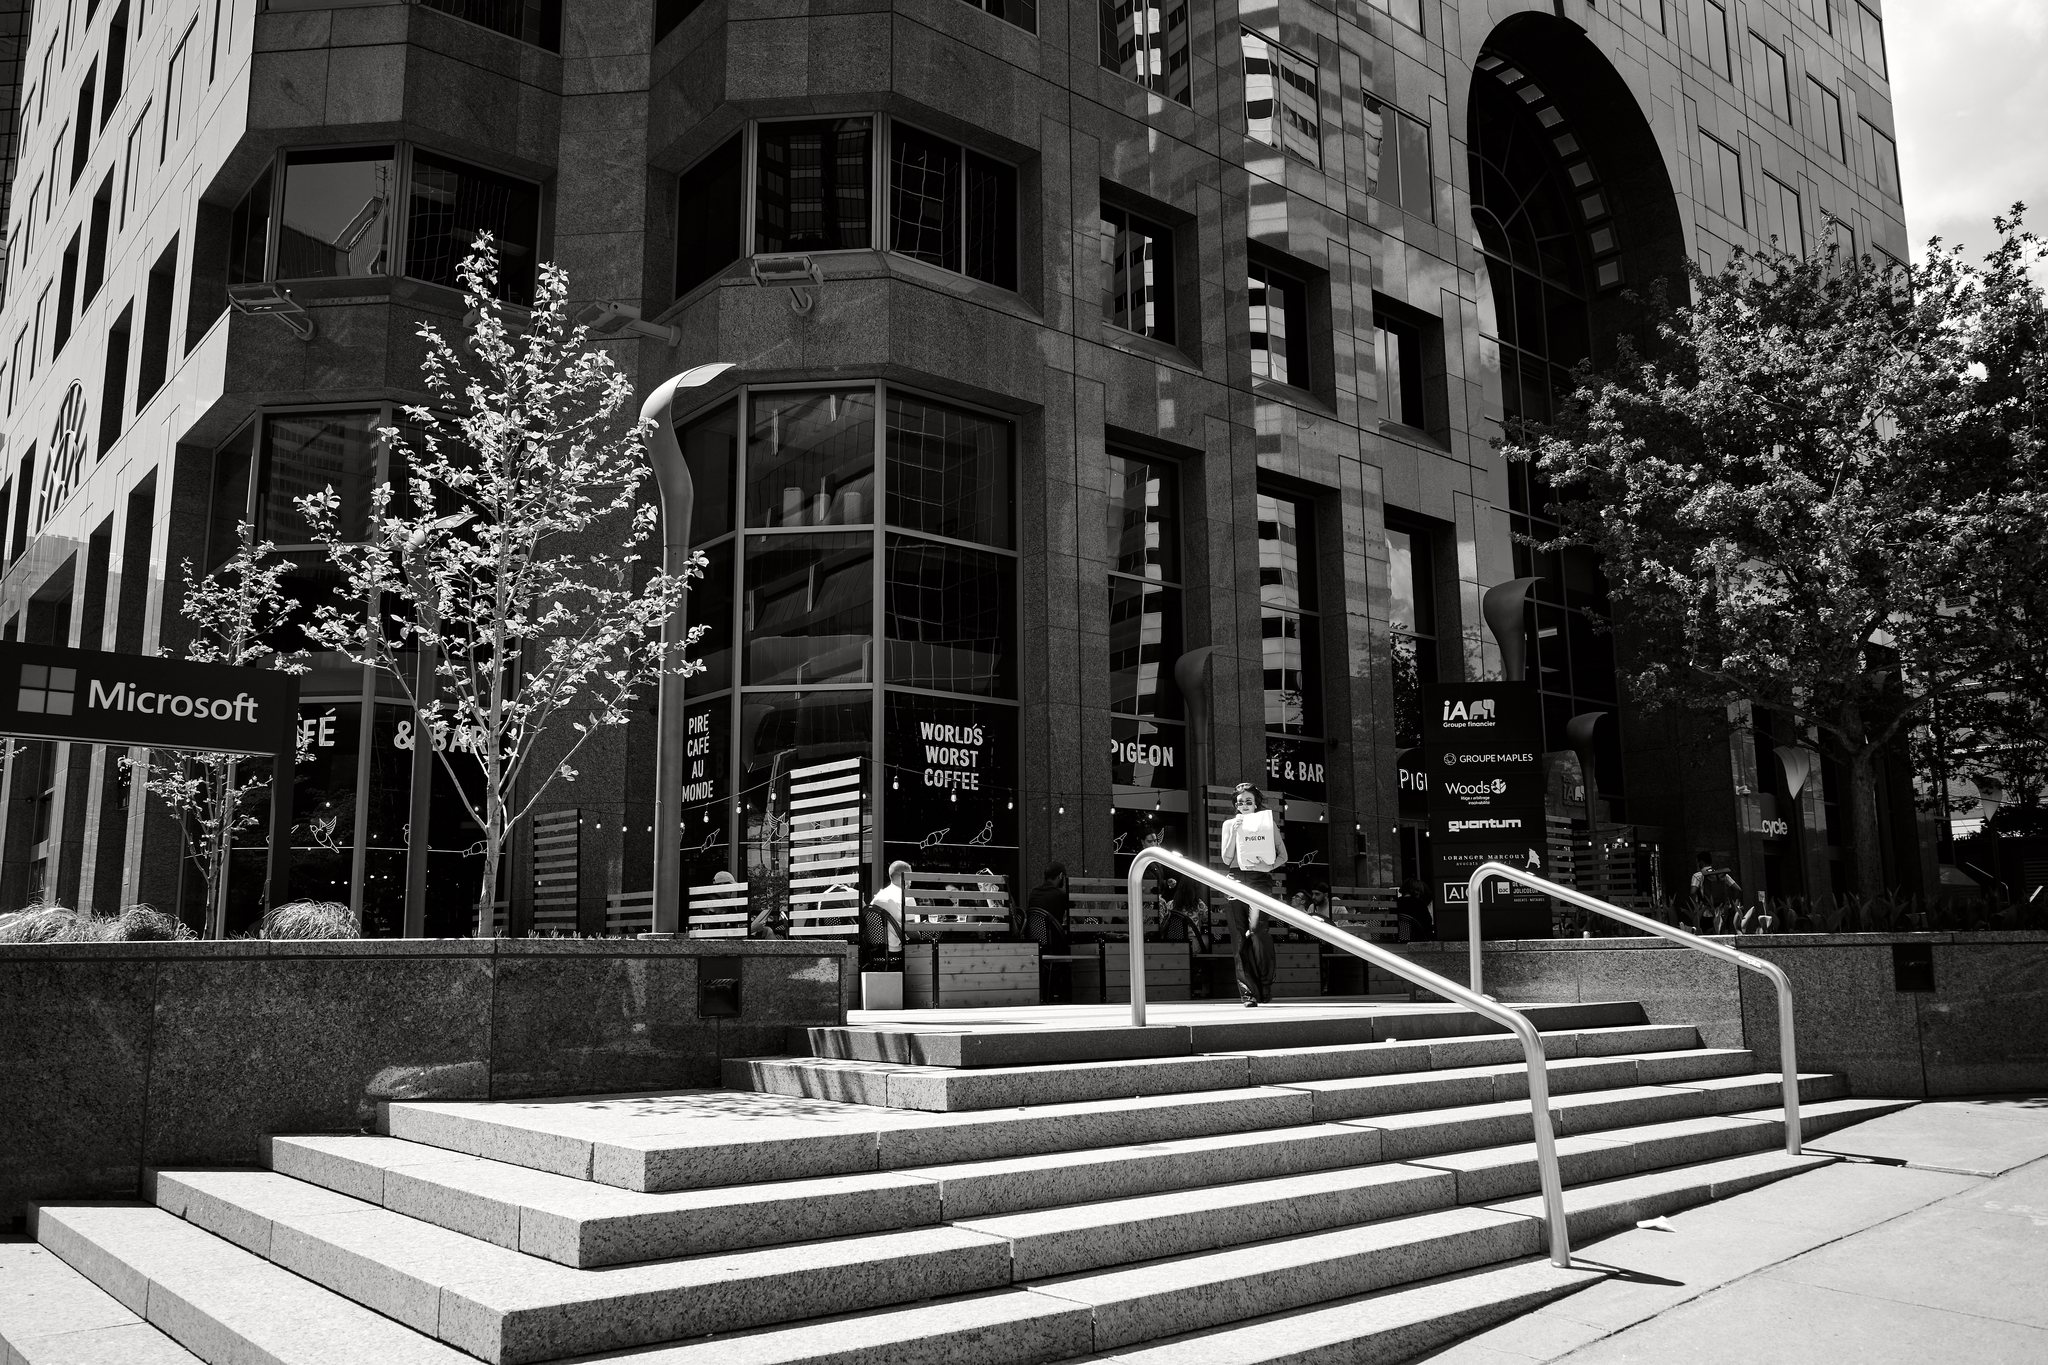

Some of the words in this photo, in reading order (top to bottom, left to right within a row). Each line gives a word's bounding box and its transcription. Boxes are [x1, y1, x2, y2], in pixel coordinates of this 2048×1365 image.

[88, 679, 259, 723] Microsoft
[920, 721, 983, 747] WORLD'S
[1443, 721, 1467, 729] Groupe
[1467, 720, 1496, 728] financier
[687, 731, 709, 758] CAFÉ
[925, 745, 979, 768] WORST
[1459, 754, 1496, 763] GROUPE
[1497, 753, 1534, 762] MAPLES
[691, 759, 704, 780] AU
[924, 768, 979, 791] COFFEE
[1284, 760, 1296, 781] &
[1299, 761, 1325, 783] BAR
[681, 779, 714, 803] MONDE
[1445, 780, 1491, 795] Woods
[1448, 818, 1522, 832] quantum
